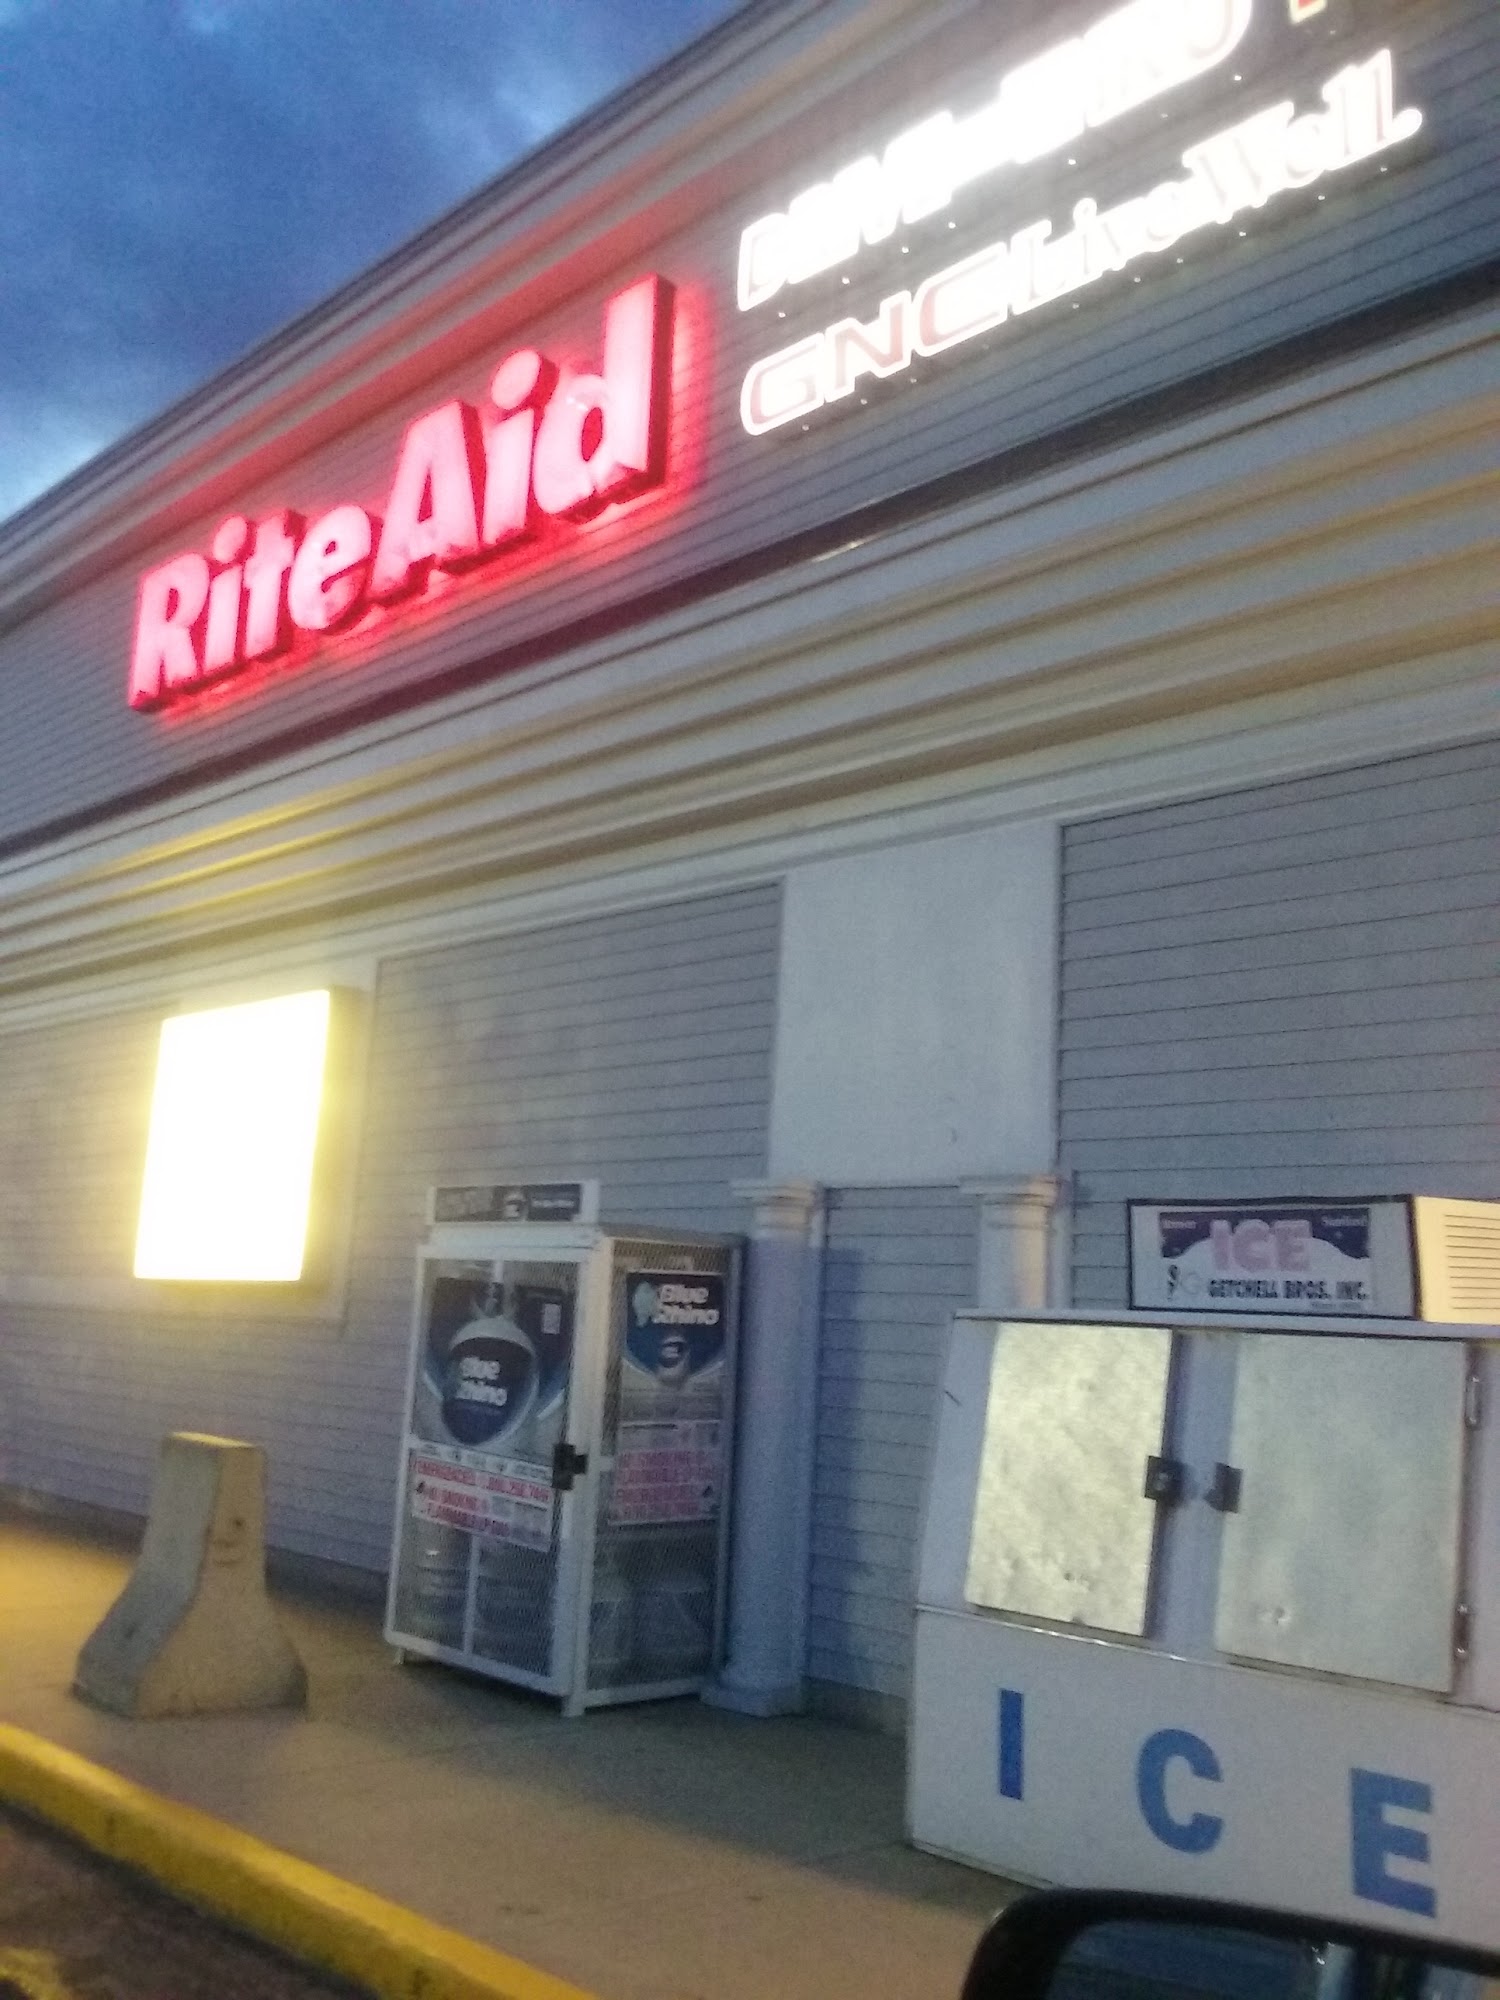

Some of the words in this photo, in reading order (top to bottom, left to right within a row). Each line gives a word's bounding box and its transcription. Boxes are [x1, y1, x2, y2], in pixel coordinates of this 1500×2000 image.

[740, 242, 1008, 435] GNC
[129, 508, 379, 709] Rite
[369, 272, 674, 602] Aid
[1209, 1218, 1312, 1272] ICE
[997, 1686, 1437, 1919] ICE
